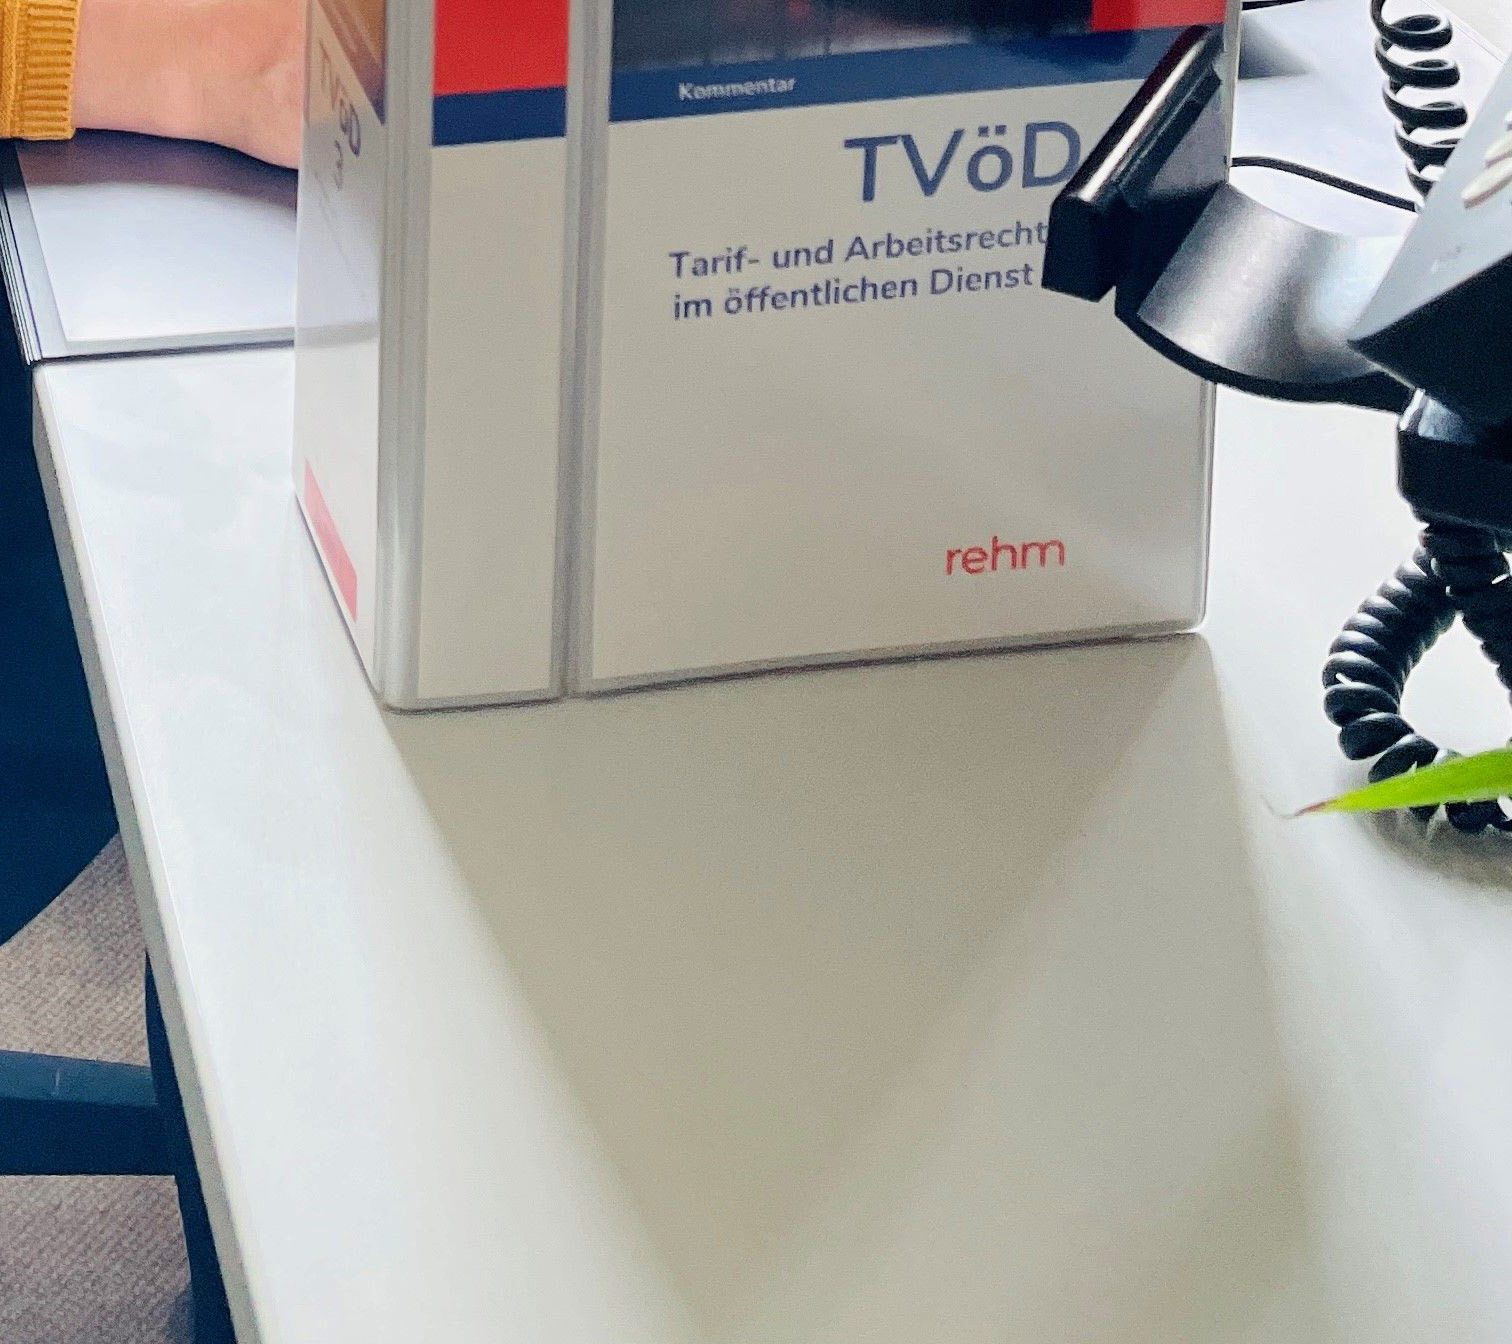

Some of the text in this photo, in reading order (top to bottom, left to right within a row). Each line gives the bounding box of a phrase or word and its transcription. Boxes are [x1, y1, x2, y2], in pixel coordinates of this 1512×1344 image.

[678, 77, 797, 101] Kommentar
[844, 121, 1082, 202] TVöD
[670, 221, 1048, 279] Tarif- und Arbeitsrecht
[673, 263, 1033, 321] im öffentlichen Dienst
[946, 535, 1065, 575] rehm
